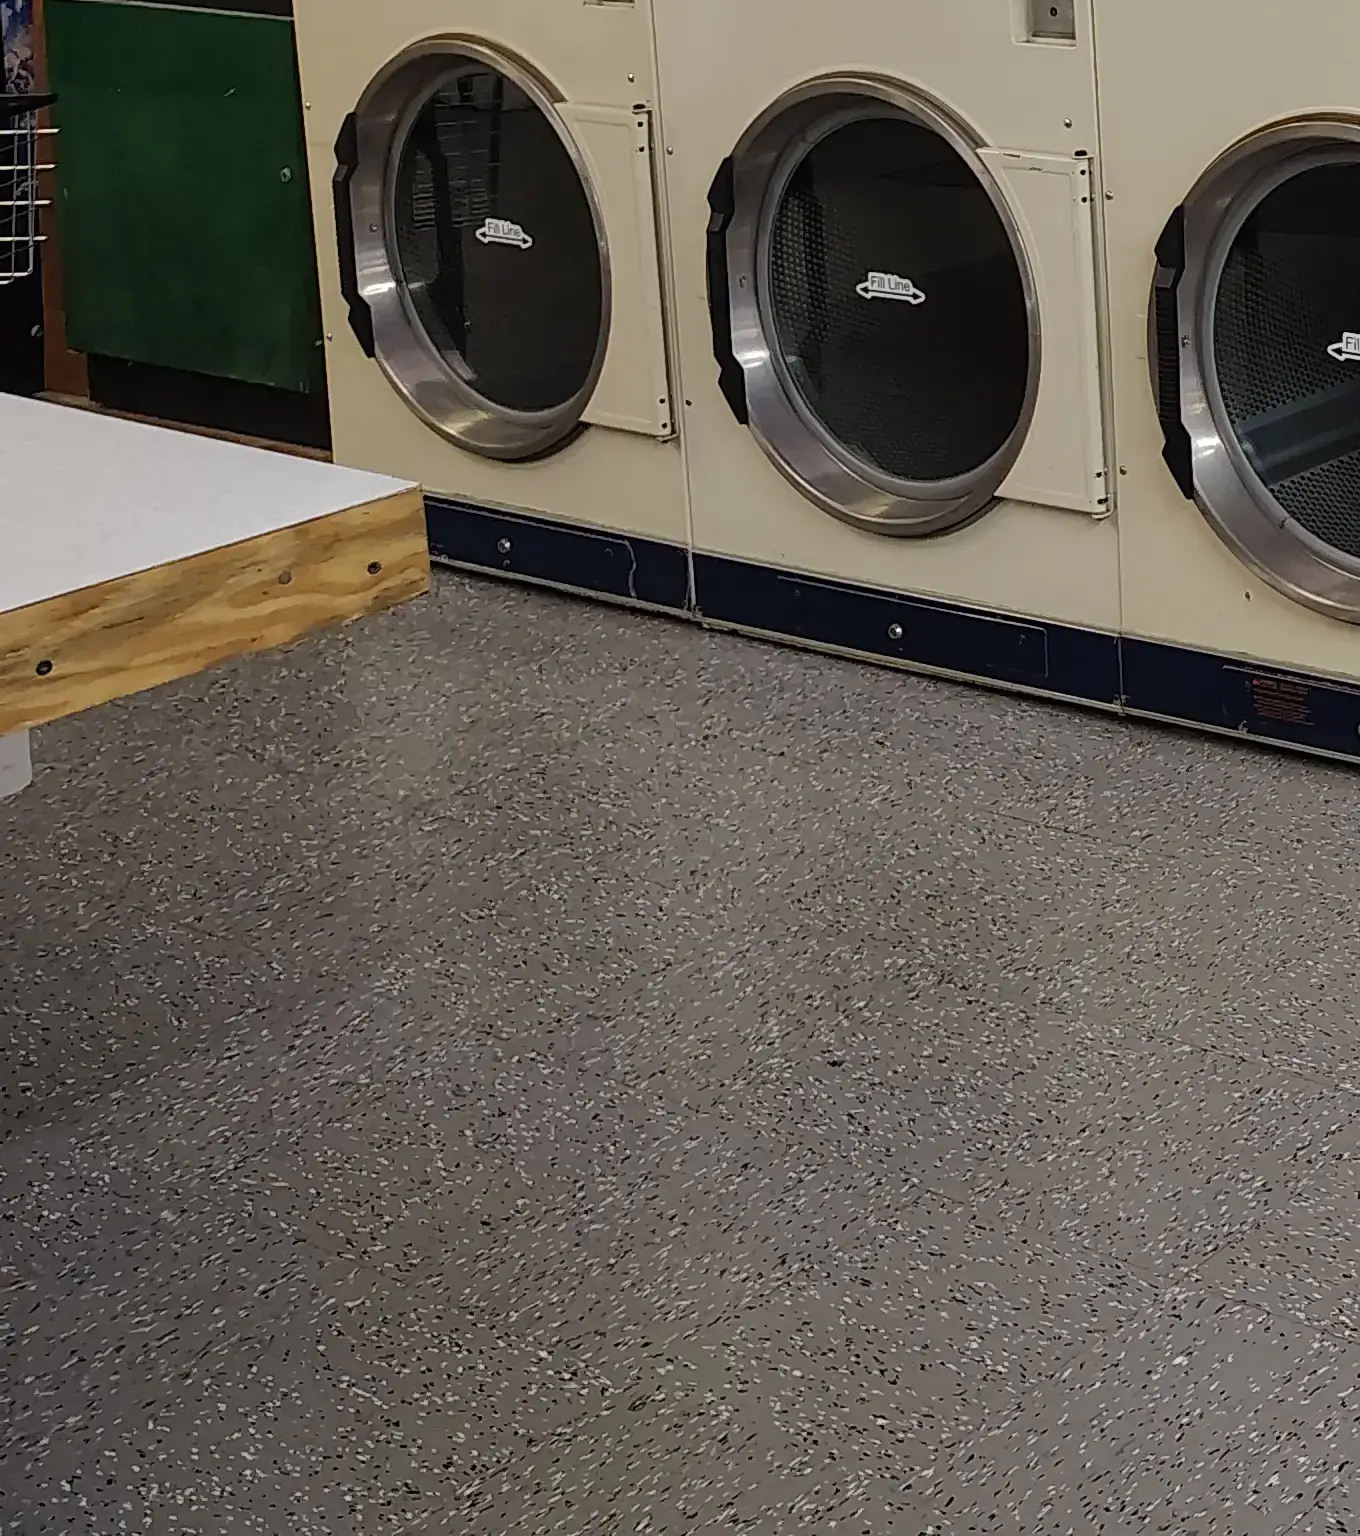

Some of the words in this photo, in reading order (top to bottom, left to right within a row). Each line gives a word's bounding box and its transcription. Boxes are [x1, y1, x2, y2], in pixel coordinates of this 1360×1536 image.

[487, 222, 501, 235] Fill
[502, 224, 521, 238] Line
[870, 276, 887, 290] Fill
[888, 278, 910, 293] Line
